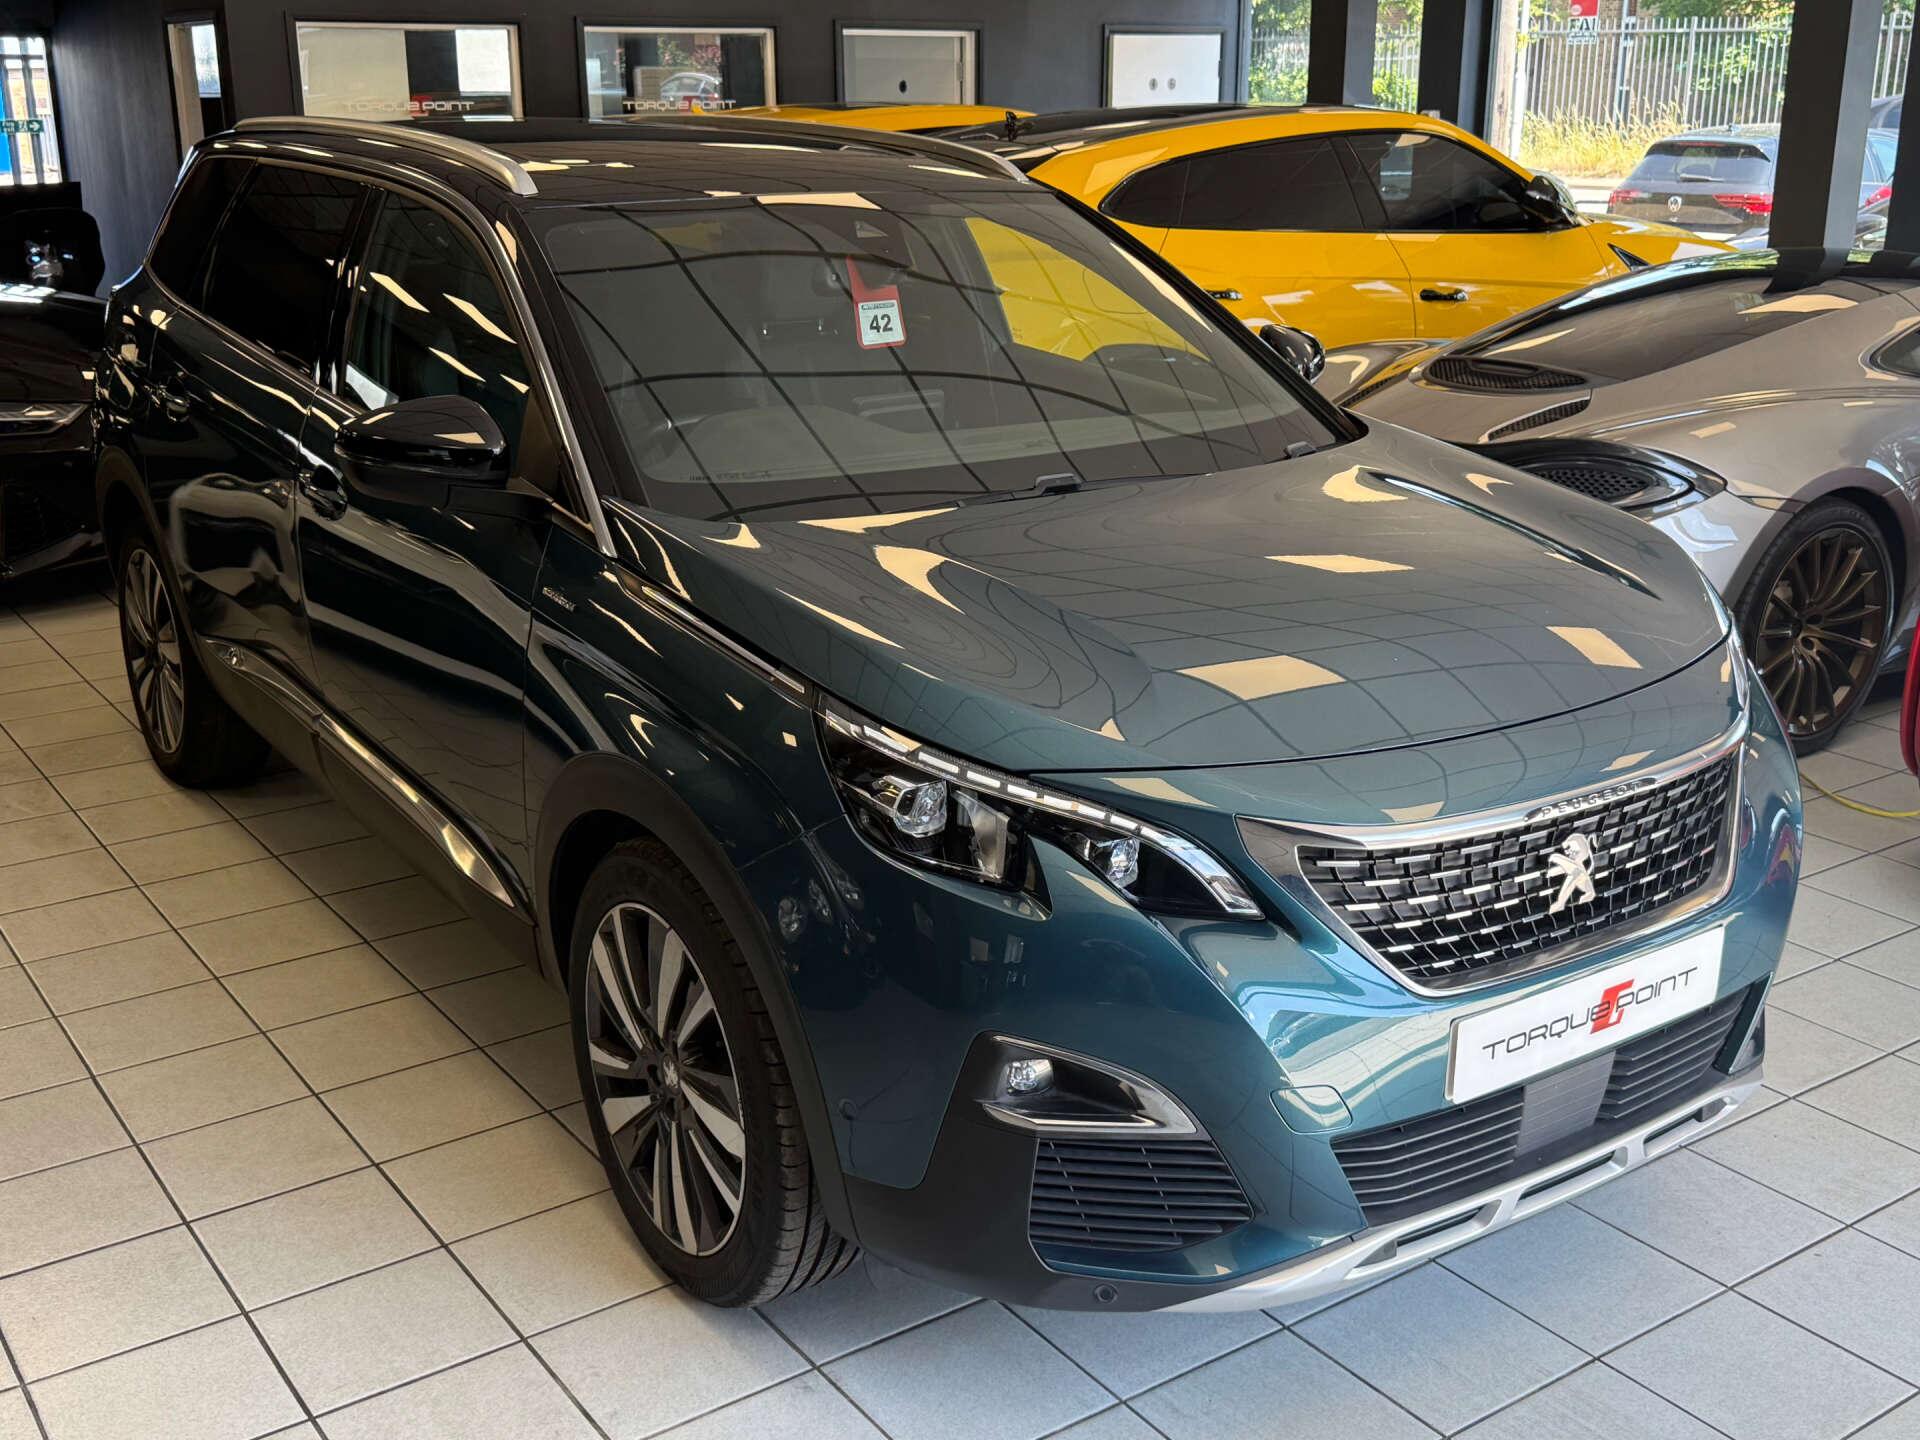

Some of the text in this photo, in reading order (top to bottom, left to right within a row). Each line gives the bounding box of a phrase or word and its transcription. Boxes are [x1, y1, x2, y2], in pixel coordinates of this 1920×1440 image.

[422, 101, 475, 111] POINT
[622, 101, 689, 111] TORQUE
[869, 313, 893, 333] 42
[1540, 781, 1643, 818] PEUGEOT
[1482, 966, 1698, 1060] TORQUE POINT
